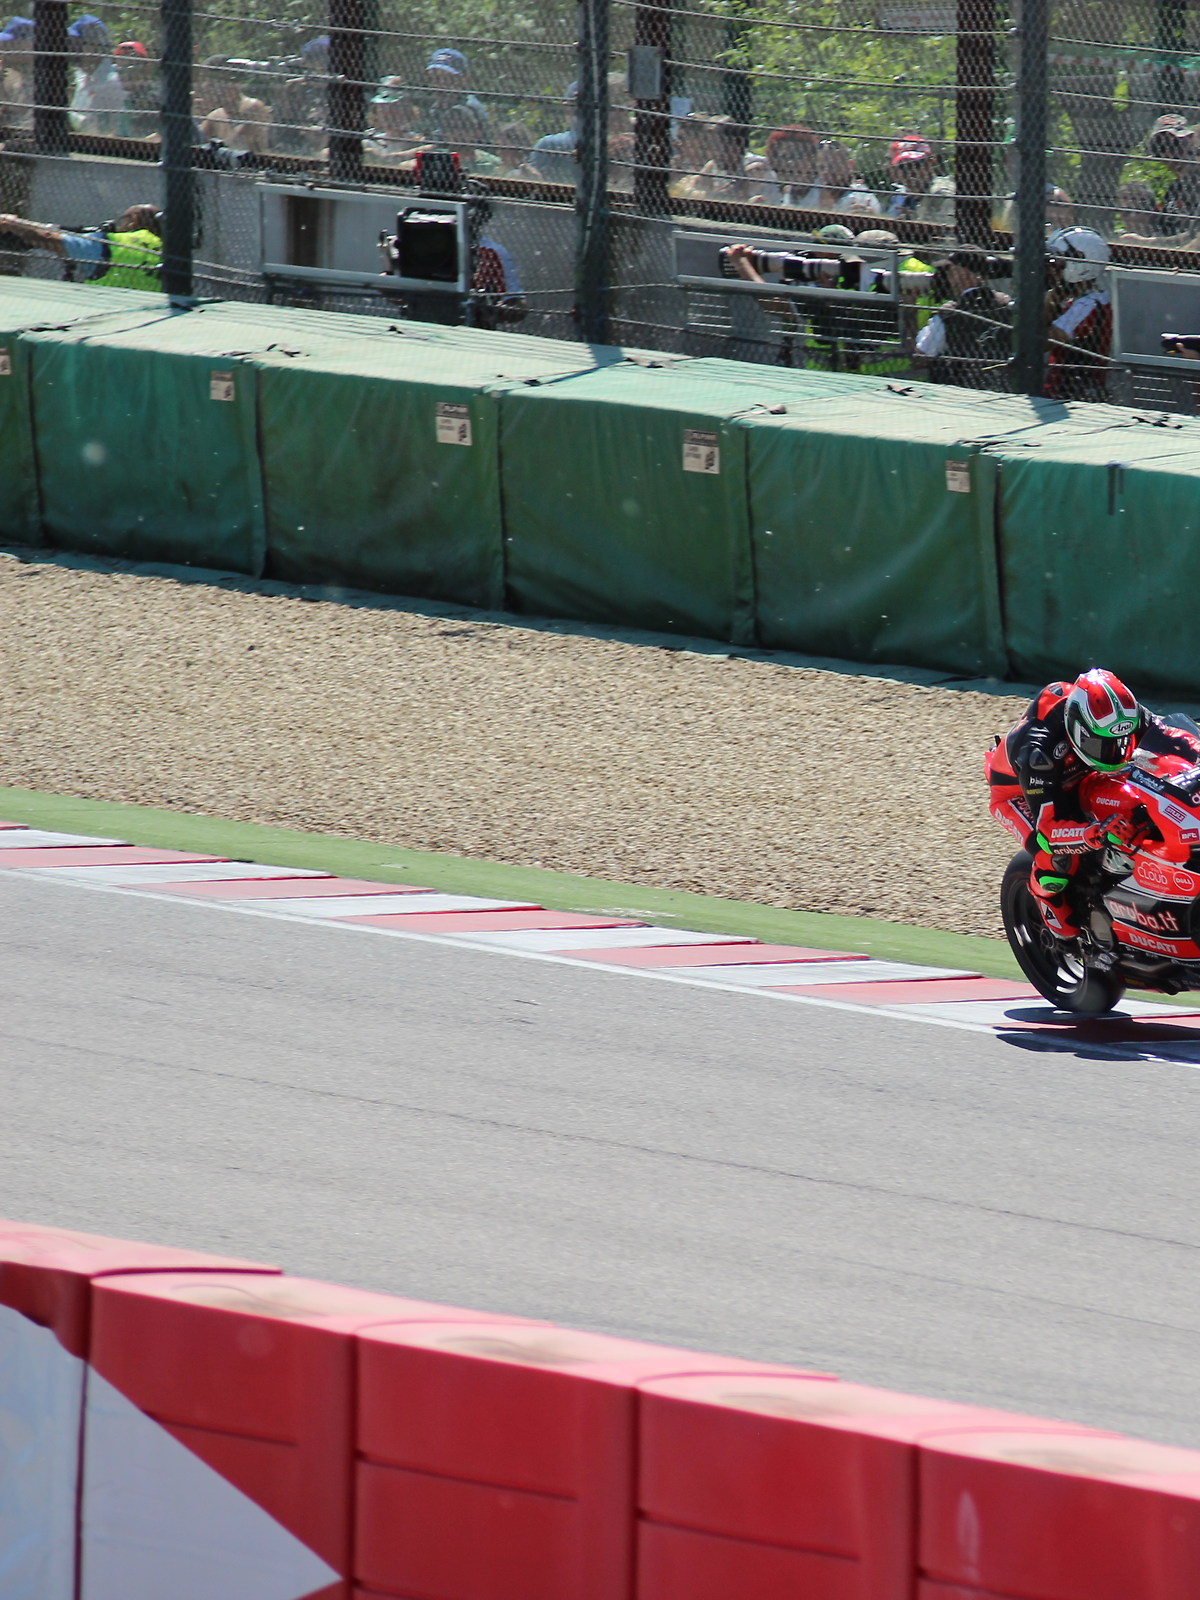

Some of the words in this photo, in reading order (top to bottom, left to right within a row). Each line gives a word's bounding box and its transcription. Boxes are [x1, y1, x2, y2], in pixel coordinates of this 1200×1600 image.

[1096, 796, 1120, 807] DUCATI
[1137, 866, 1168, 885] CLOUD
[1109, 901, 1179, 932] aruba.it
[1129, 932, 1178, 954] DUCATI
